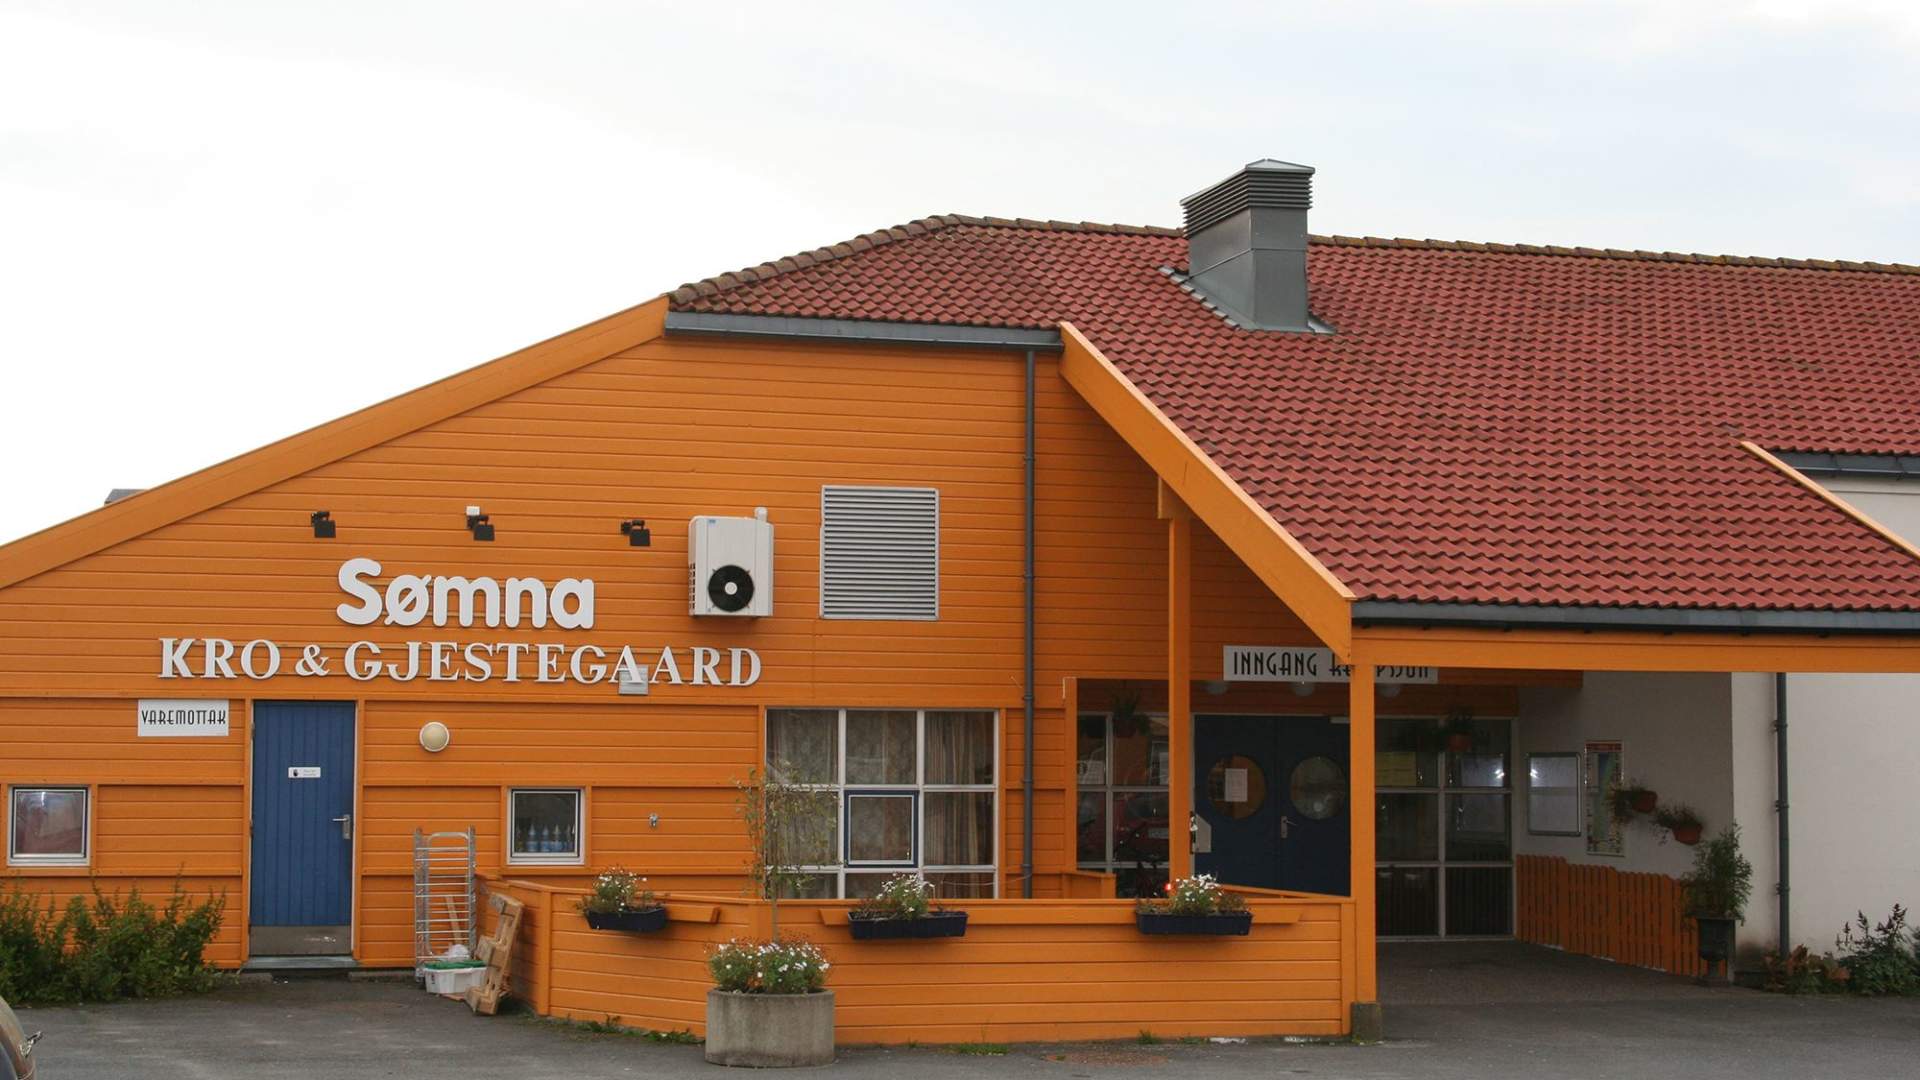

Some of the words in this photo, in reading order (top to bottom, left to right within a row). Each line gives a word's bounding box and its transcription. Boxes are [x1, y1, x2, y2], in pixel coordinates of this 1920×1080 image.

[336, 557, 595, 628] Sømna
[158, 637, 281, 680] KRO
[294, 644, 330, 677] &
[343, 641, 762, 687] GJESTEGAARD
[1233, 651, 1317, 677] INNGANG
[141, 709, 226, 725] VAREMOTTAK
